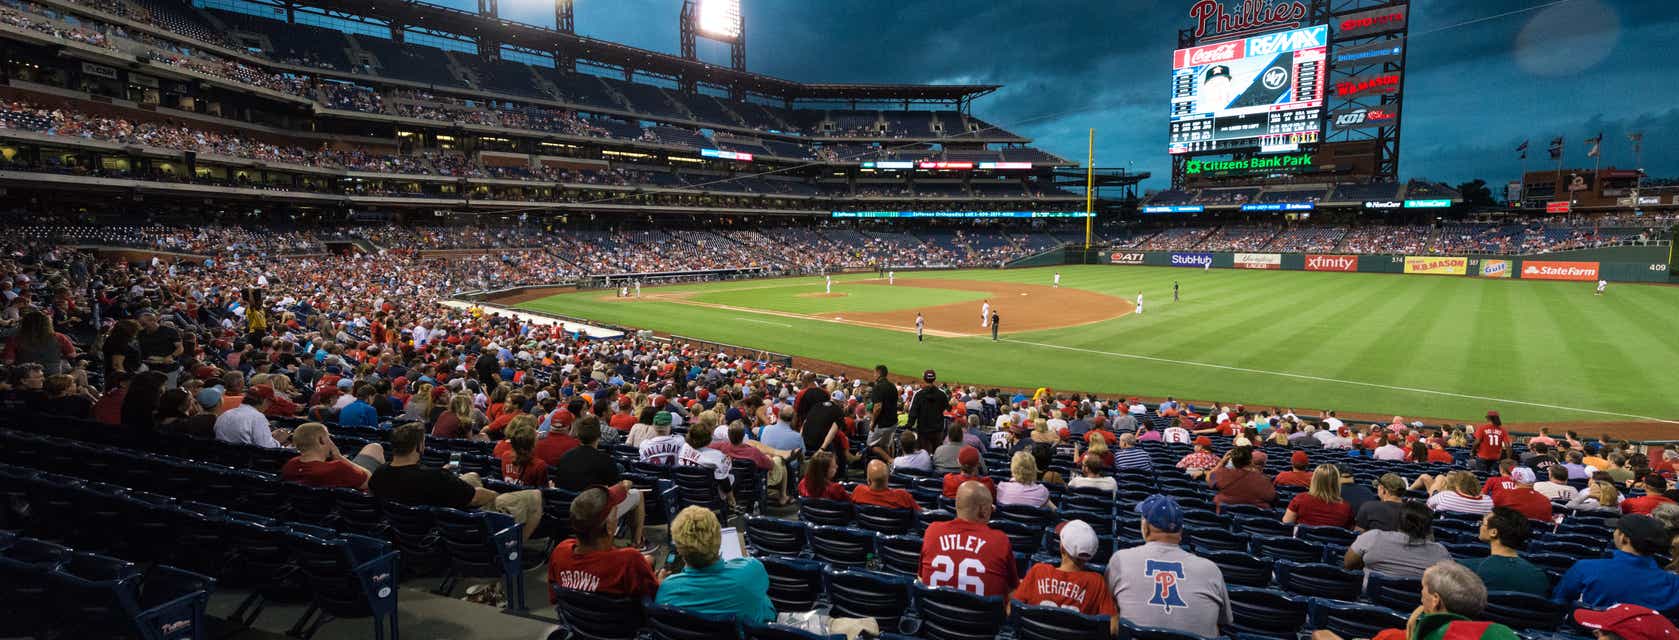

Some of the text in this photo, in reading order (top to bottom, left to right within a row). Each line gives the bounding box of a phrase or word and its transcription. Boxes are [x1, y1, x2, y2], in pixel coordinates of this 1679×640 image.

[1189, 0, 1306, 37] Phillies
[1250, 28, 1322, 56] RE/MAX
[1203, 159, 1249, 171] Citizens
[1251, 156, 1281, 168] Bank
[1283, 154, 1312, 166] Park
[1172, 254, 1212, 265] StubHub
[1308, 254, 1354, 270] xfinity
[1484, 263, 1506, 273] Gulf
[1649, 263, 1667, 271] 409
[1488, 434, 1499, 446] 11
[938, 534, 987, 554] UTLEY
[930, 554, 986, 597] 26
[1037, 577, 1086, 603] HERRERA
